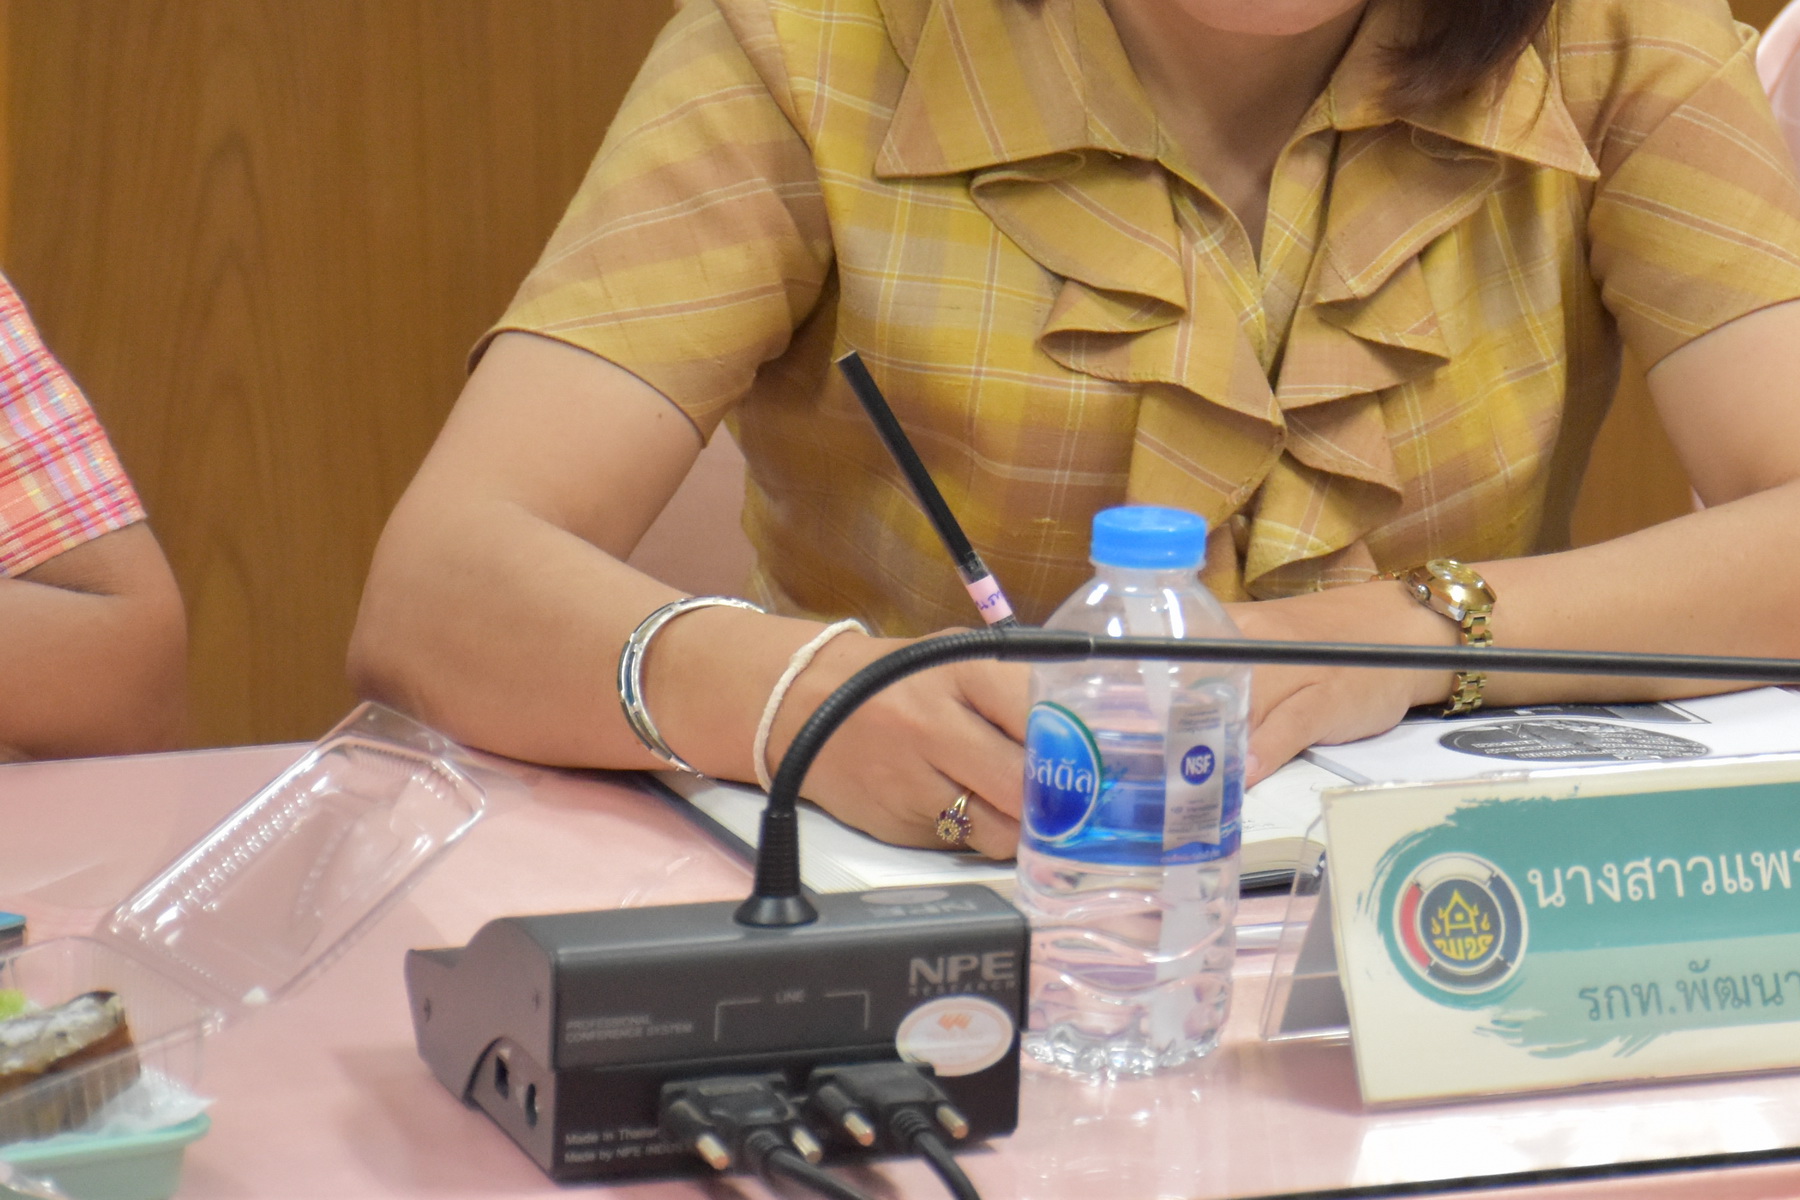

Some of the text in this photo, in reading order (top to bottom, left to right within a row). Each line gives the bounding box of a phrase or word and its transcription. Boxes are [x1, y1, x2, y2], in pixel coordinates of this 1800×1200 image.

[1027, 748, 1093, 794] ริสตัล
[1185, 754, 1212, 776] NSF
[908, 952, 1016, 986] NPE
